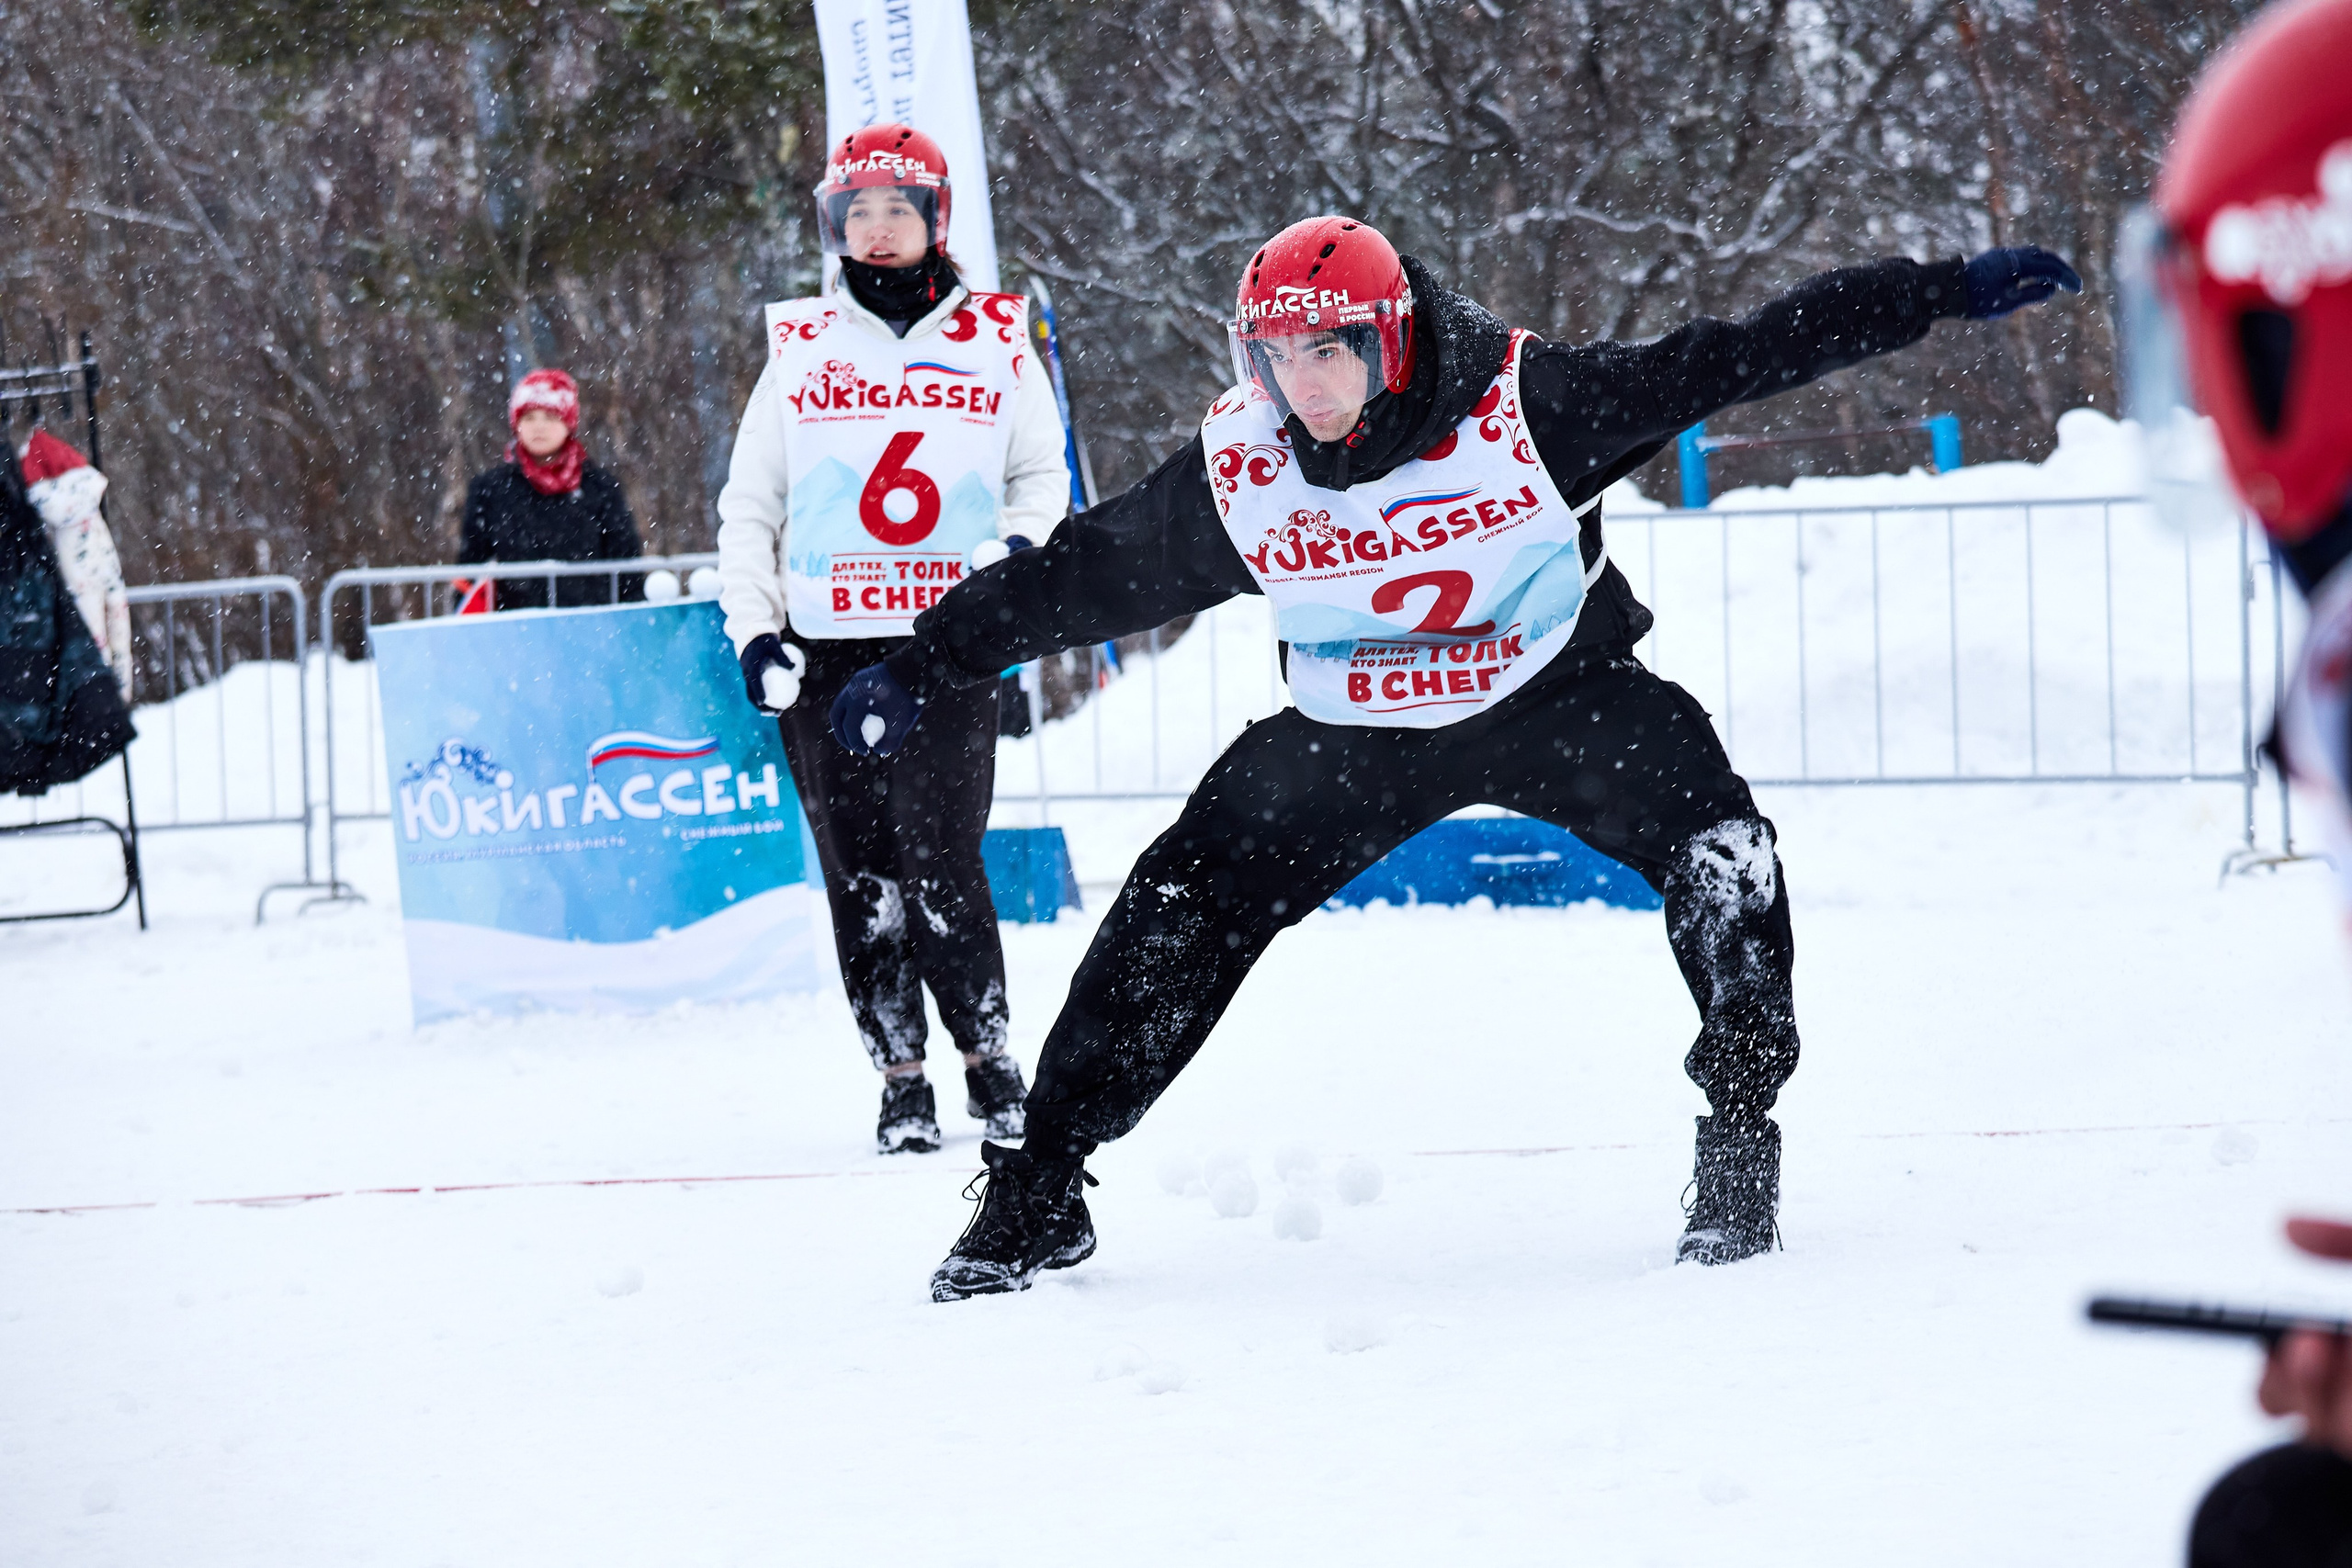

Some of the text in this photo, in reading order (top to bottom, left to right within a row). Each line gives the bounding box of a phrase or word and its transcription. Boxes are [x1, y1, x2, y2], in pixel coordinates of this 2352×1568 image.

[884, 0, 915, 83] итет
[1338, 303, 1370, 314] ПЕРВЫЕ
[1346, 311, 1376, 322] РОССИИ
[859, 432, 941, 547] 6
[1477, 506, 1544, 543] СНЕЖНЫЙ БОЙ
[832, 561, 887, 572] ДЛЯ ТЕХ,
[894, 561, 963, 581] ТОЛК
[1298, 571, 1348, 582] MURMANSK
[1350, 567, 1385, 577] REGION
[831, 574, 850, 582] КТО
[831, 586, 955, 612] В СНЕГ
[1372, 570, 1496, 637] 2
[1353, 646, 1419, 658] ДЛЯ ТЕХ,
[1428, 633, 1525, 663] ТОЛК
[1351, 656, 1417, 668] КТО ЗНАЕТ
[1348, 663, 1511, 703] В СНЕГ
